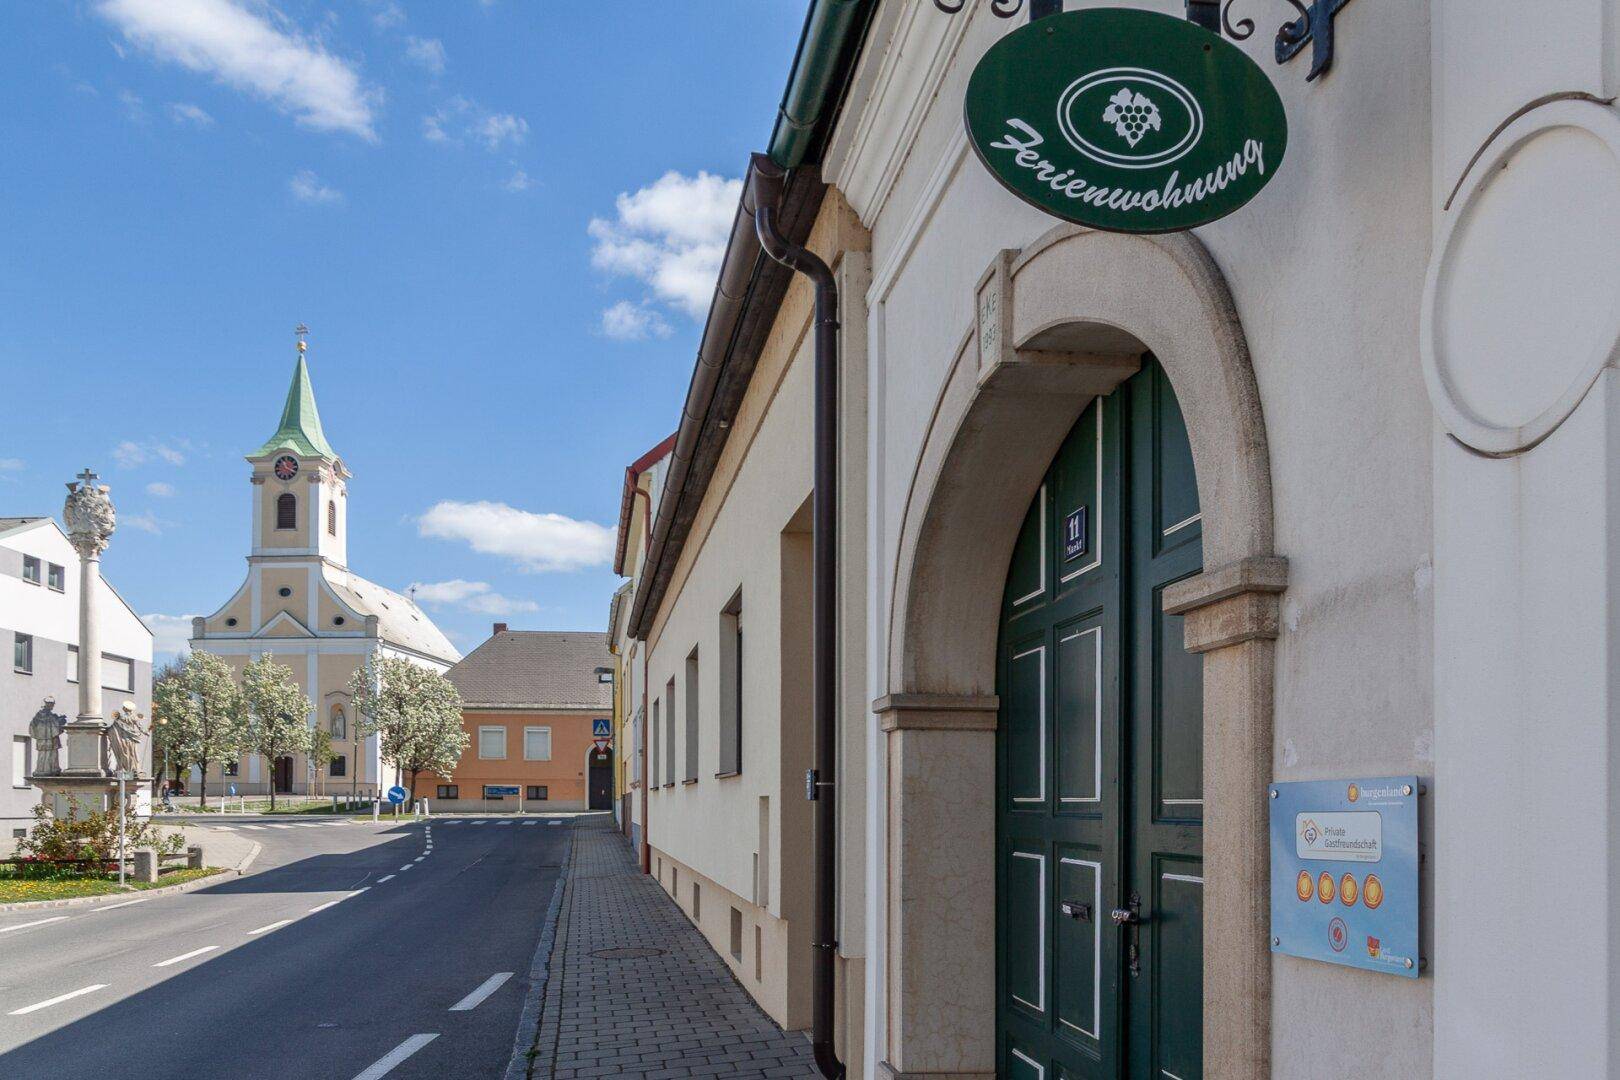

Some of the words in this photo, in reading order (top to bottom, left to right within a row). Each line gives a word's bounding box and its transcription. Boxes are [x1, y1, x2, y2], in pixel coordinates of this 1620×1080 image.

[990, 118, 1264, 212] Ferienwohnung
[1069, 515, 1079, 541] 11
[1324, 827, 1346, 837] Private
[1324, 838, 1377, 850] Gastfreundschaft
